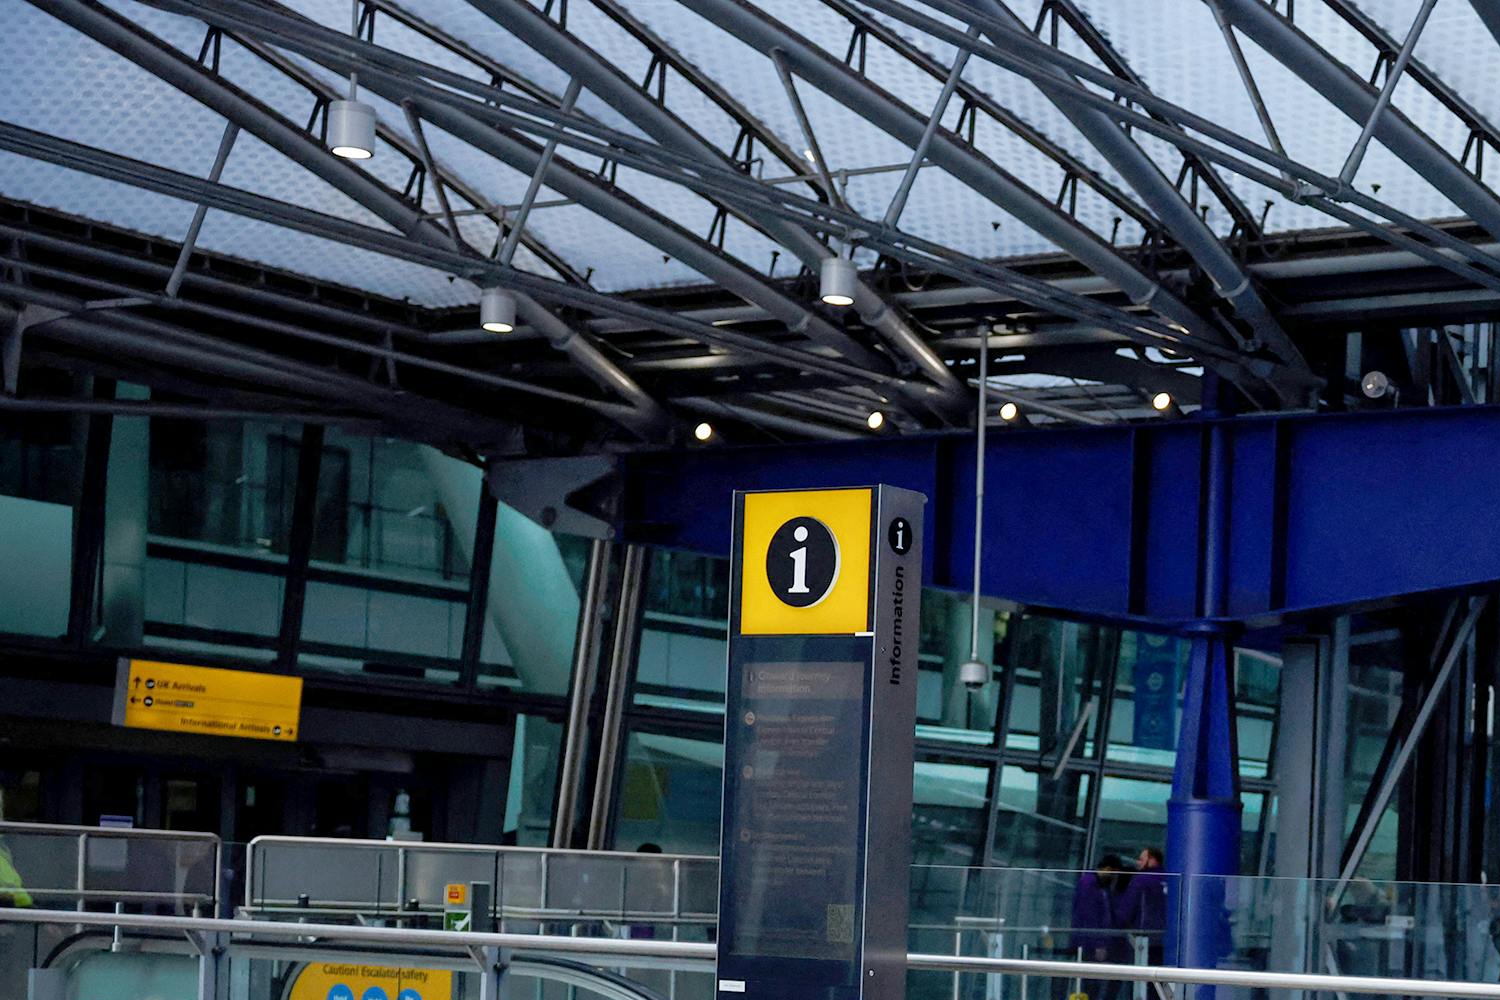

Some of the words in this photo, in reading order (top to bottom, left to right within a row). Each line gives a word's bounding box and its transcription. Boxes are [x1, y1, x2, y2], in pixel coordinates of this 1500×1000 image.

[888, 566, 904, 685] Information
[172, 681, 206, 693] Arrivals
[322, 963, 359, 977] Caution!
[361, 965, 399, 979] Escalator
[401, 968, 428, 983] safety
